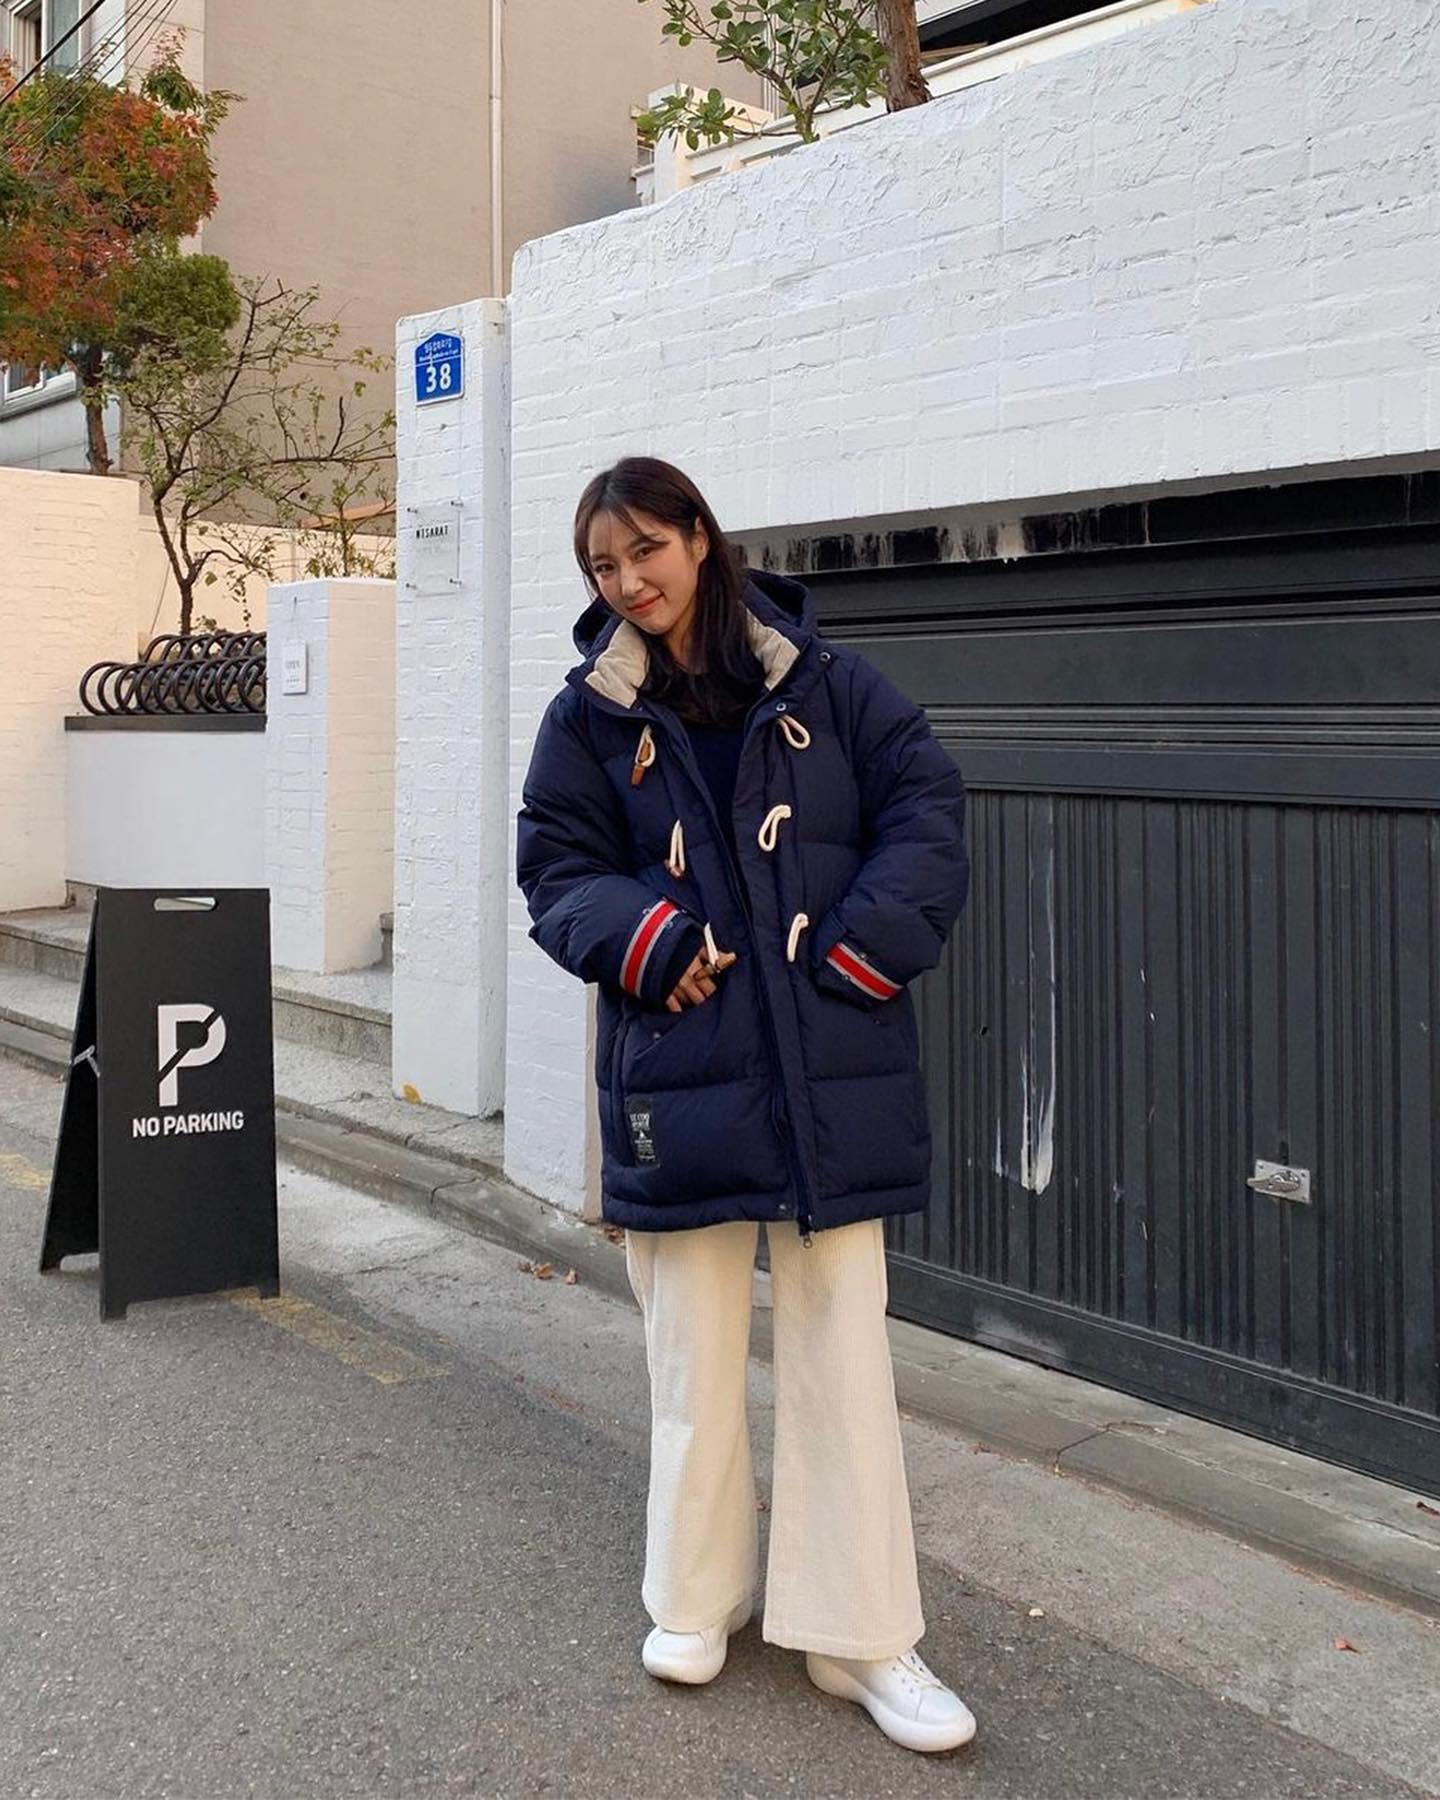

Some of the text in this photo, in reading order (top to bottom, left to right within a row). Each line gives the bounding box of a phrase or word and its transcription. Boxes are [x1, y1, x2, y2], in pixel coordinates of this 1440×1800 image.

[426, 363, 452, 393] 38
[158, 1003, 227, 1107] P
[132, 1110, 244, 1138] NO PARKING
